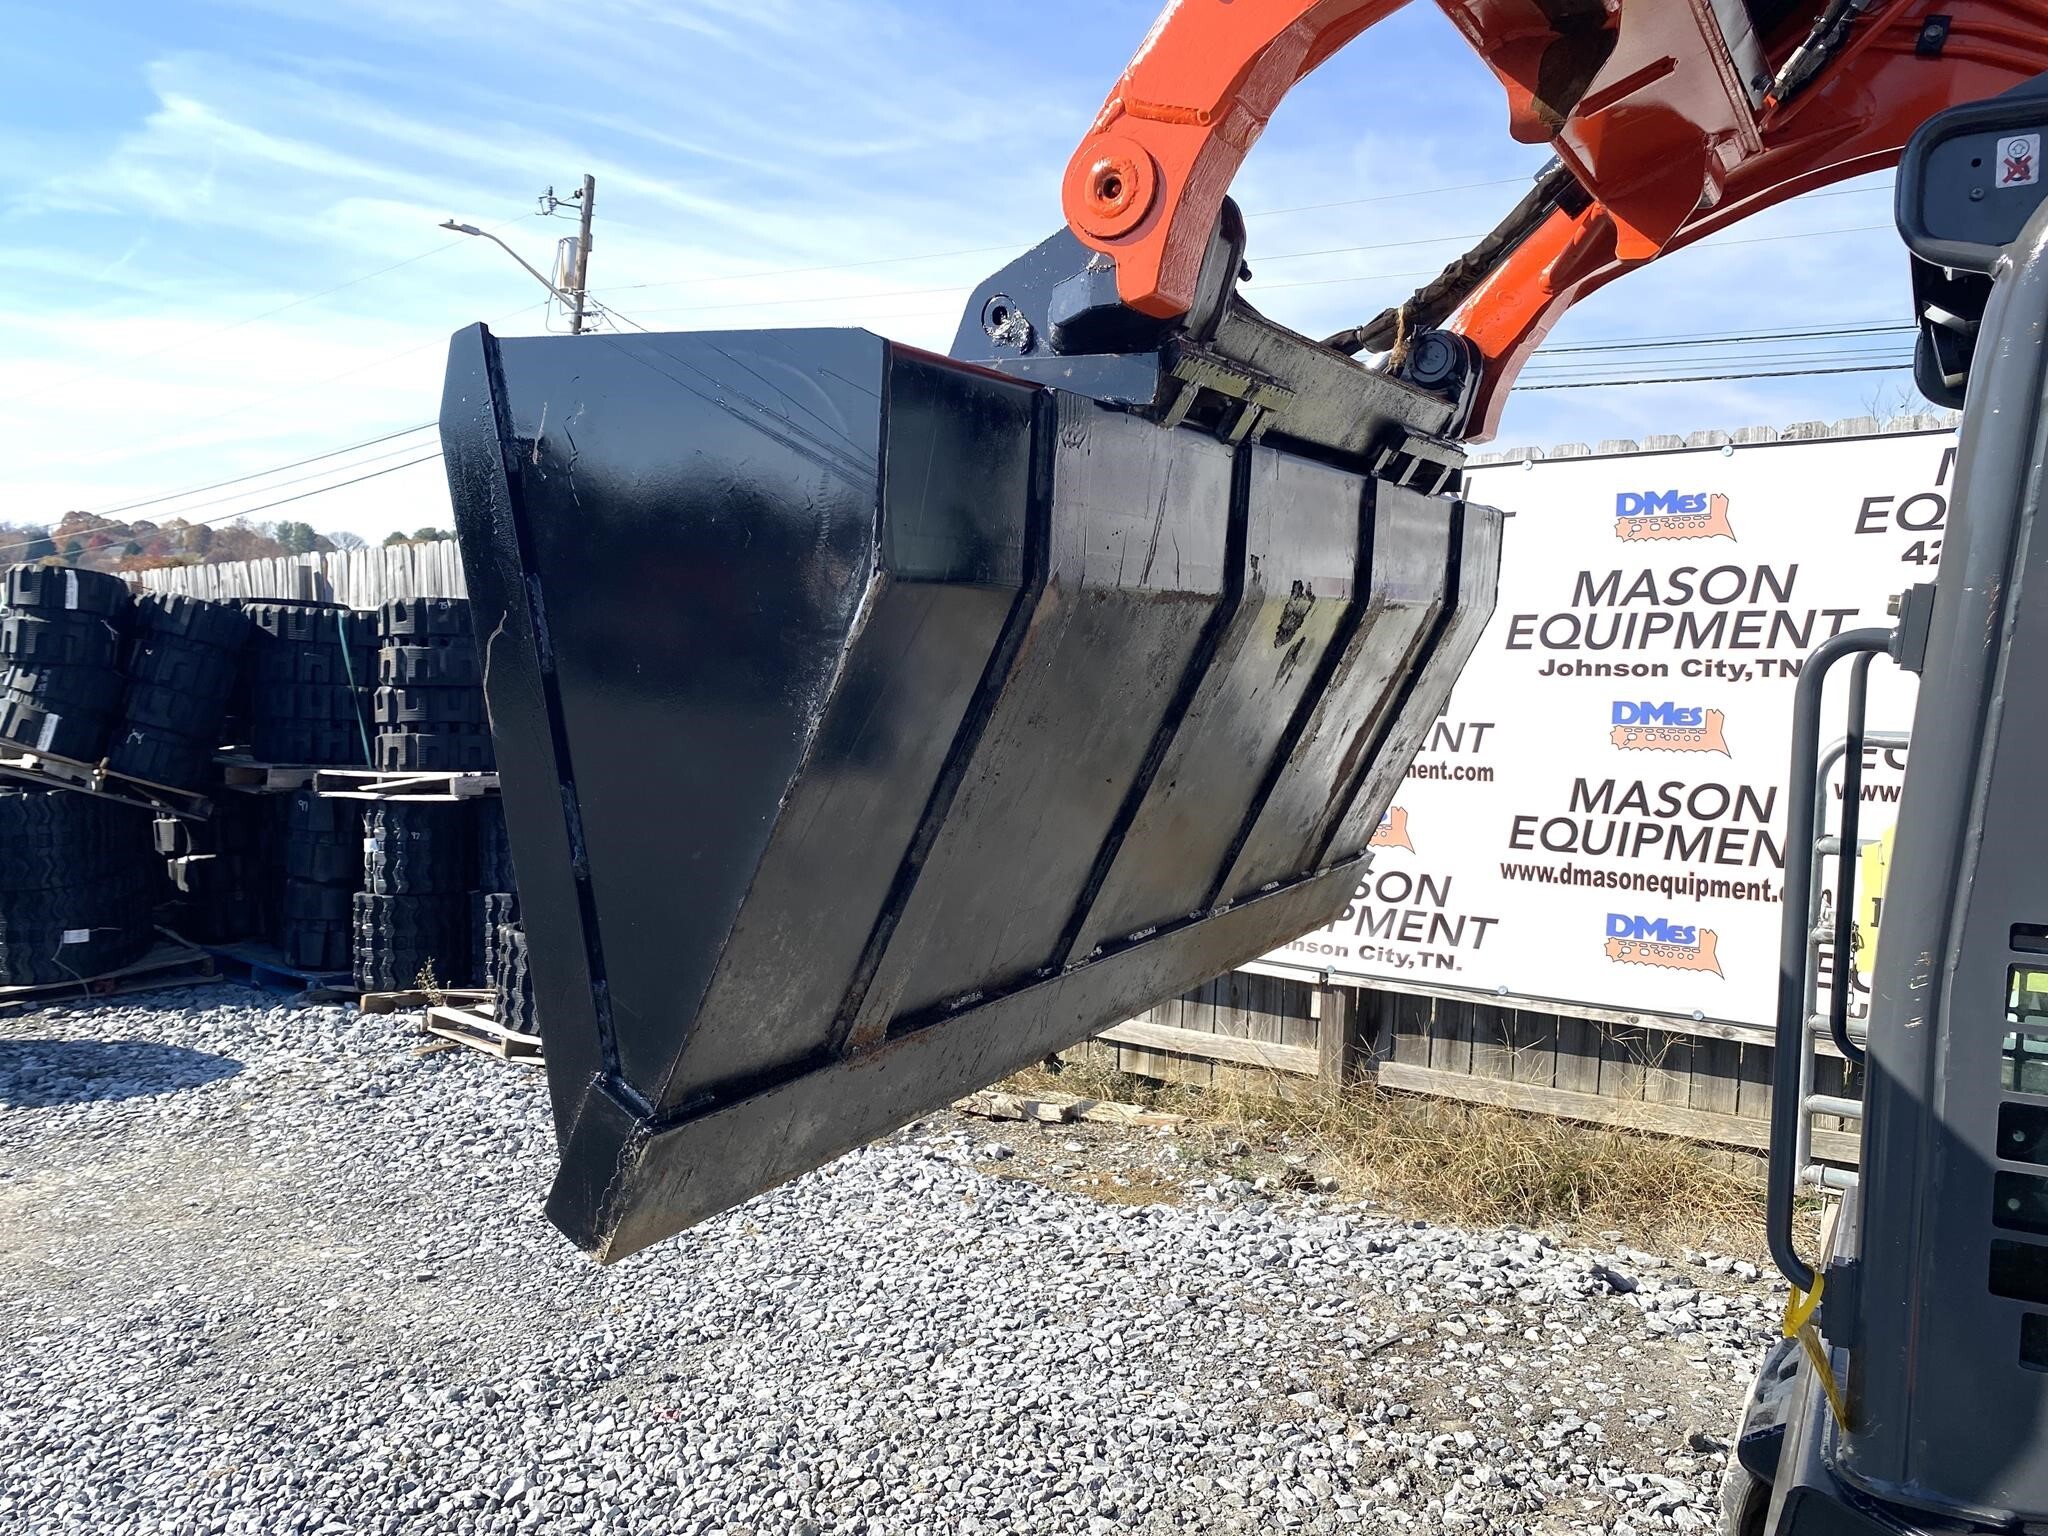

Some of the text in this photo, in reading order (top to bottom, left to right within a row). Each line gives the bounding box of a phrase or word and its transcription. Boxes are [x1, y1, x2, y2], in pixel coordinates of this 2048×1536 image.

[1571, 564, 1799, 607] MASON
[1505, 608, 1860, 650] EQUIPMENT
[1538, 659, 1668, 678] Johnson
[1569, 777, 1777, 824] MASON
[1508, 815, 1786, 869] EQUIPMEN
[1352, 868, 1452, 908] SON
[1500, 862, 1832, 906] www.dmasonequipment.
[1285, 940, 1349, 958] nson
